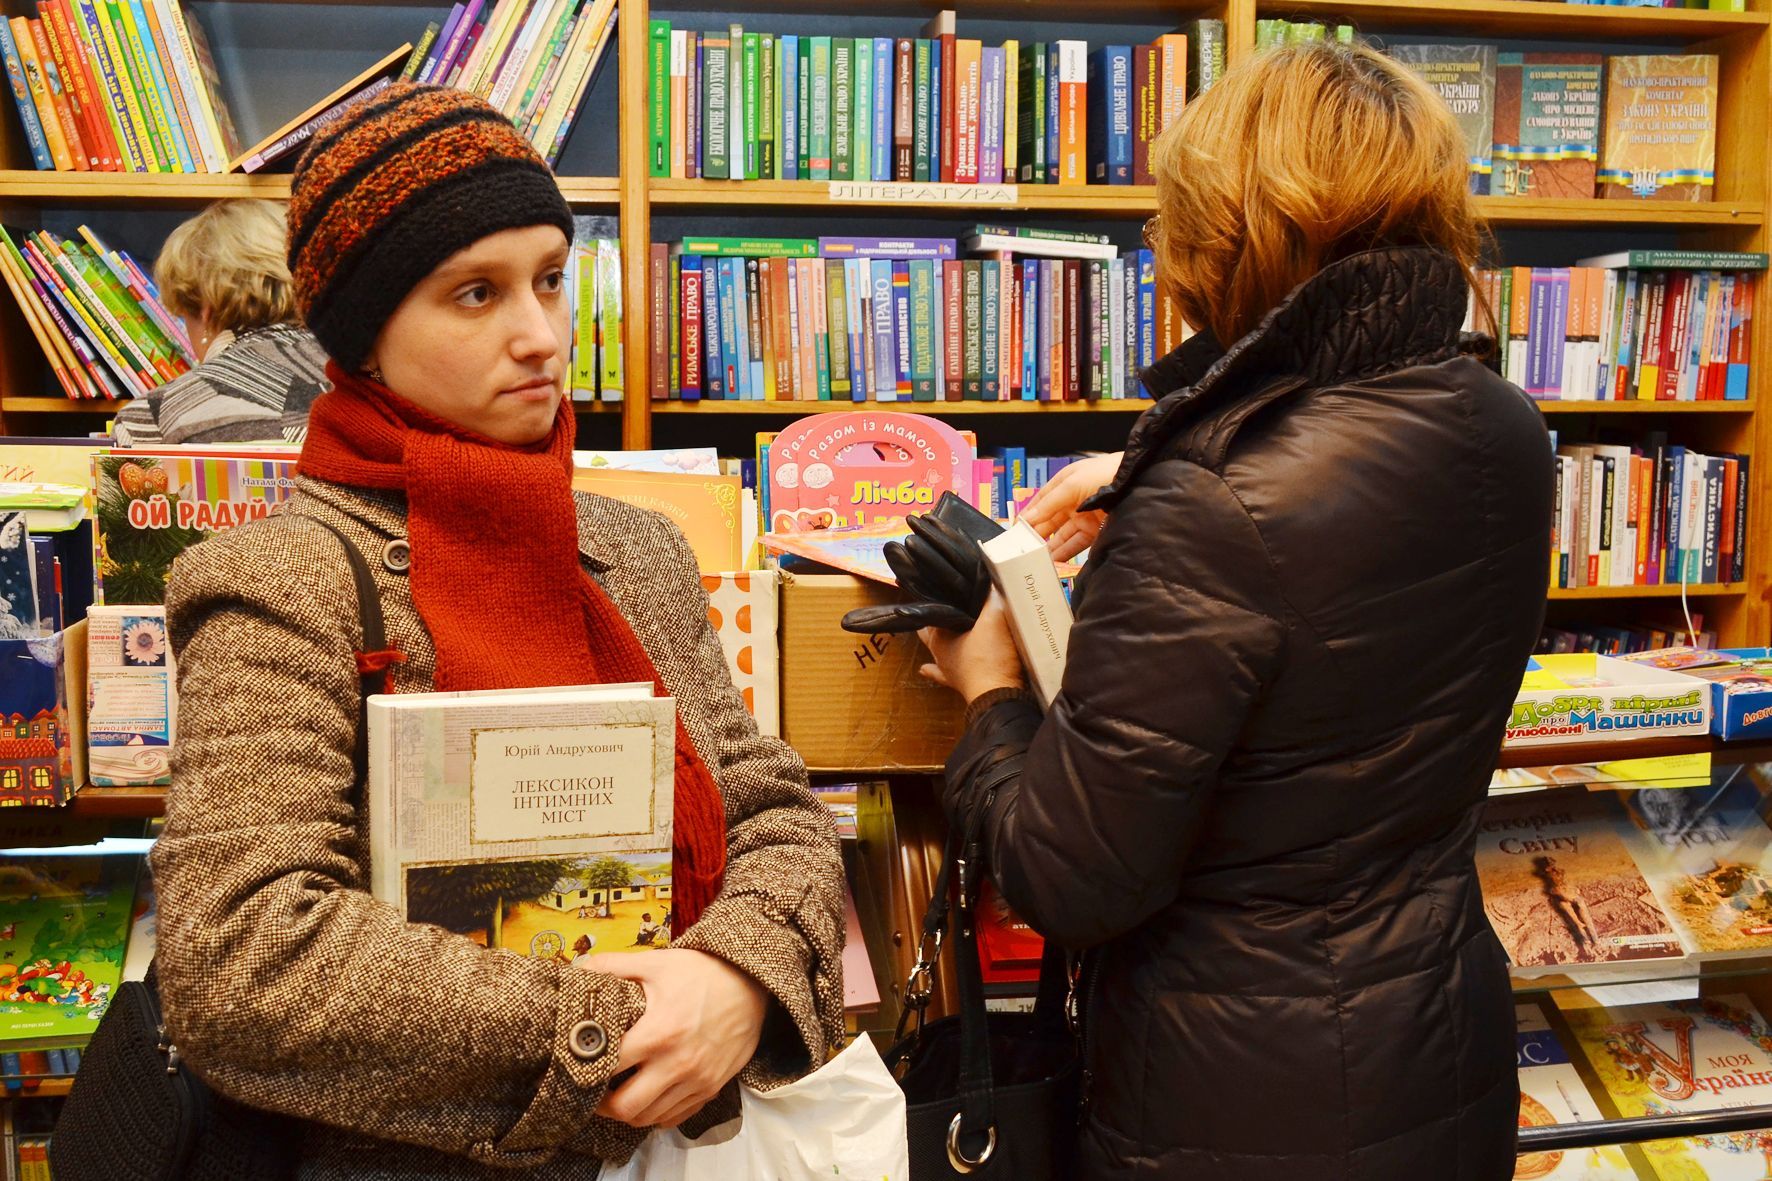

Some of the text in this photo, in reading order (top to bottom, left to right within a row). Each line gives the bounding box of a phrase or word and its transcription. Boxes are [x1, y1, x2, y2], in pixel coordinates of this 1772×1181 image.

[400, 29, 438, 76] ДИНОЗАВРИ
[655, 42, 663, 75] УКРАЇНИ
[762, 49, 770, 78] України
[1202, 31, 1212, 80] СІМЕЙНЕ
[105, 75, 118, 94] ніч
[655, 76, 663, 101] ПРАВО
[764, 79, 772, 97] право
[899, 54, 909, 133] Трудове право України
[918, 46, 927, 156] ТРУДОВЕ ПРАВО УКРАЇНИ
[1114, 56, 1129, 134] ЦИВІЛЬНЕ ПРАВО
[1440, 82, 1480, 98] УКРАЇНИ
[1531, 90, 1596, 102] ЗАКОНУ УКРАЇНИ
[1623, 76, 1708, 87] НАУКОВО-ПРАКТИЧНИЙ
[1646, 90, 1684, 100] КОМЕНТАР
[655, 103, 663, 136] АГРАРНЕ
[707, 49, 725, 155] ЕКОЛОГІЧНЕ ПРАВО УКРАЇНИ
[815, 76, 826, 135] ЗЕМЕЛЬНЕ ПРАВО
[836, 48, 848, 156] ЗЕМЕЛЬНЕ ПРАВО УКРАЇНИ
[967, 61, 977, 177] правових документів
[1564, 104, 1595, 114] МІСЦЕВЕ
[1622, 101, 1708, 117] ЗАКОНУ УКРАЇНИ
[956, 81, 967, 177] Зразки цивільно-
[834, 186, 1011, 200] ЛІТЕРАТУРА
[705, 267, 719, 357] МІЖНАРОДНЕ ПРАВО
[876, 278, 891, 334] ПРАВО
[915, 269, 932, 373] ПОДАТКОВЕ ПРАВО України
[949, 270, 960, 375] СІМЕЙНЕ ПРАВО України
[966, 270, 979, 373] УКРАЇНСЬКЕ СІМЕЙНЕ ПРАВО
[985, 270, 998, 374] СІМЕЙНЕ ПРАВО України
[1127, 298, 1135, 345] ПРОКУРАТУРА
[1164, 296, 1172, 324] Україні
[686, 277, 697, 385] РИМСЬКЕ ПРАВО
[898, 297, 909, 372] ПРАВОЗНАВСТВО
[1114, 313, 1122, 367] ПРОКУРАТУРА
[1142, 292, 1152, 366] ПРОКУРАТУРА УКРАЇНИ
[808, 419, 936, 461] Разом із мамою
[241, 476, 276, 487] Наталя
[852, 486, 935, 513] Лічба
[130, 496, 279, 531] ОЙ РАДУЙ
[1581, 494, 1589, 538] МЕНЕДЖМЕНТ
[1670, 495, 1679, 543] СТАТИСТИКА
[1705, 477, 1717, 566] СТАТИСТИКА
[1736, 471, 1745, 566] ДОСЛІДЖЕННЯ ОПЕРАЦІЙ
[1021, 572, 1065, 661] Юрій Андрухович
[1508, 691, 1702, 729] Добрі вірші
[1540, 709, 1704, 732] про Машинки
[504, 743, 624, 758] Юрій Андрухович
[1506, 724, 1584, 739] улюблені
[511, 776, 615, 793] ЛЕКСИКОН
[513, 792, 614, 809] ІНТИМНИХ
[541, 809, 586, 825] МІСТ
[1480, 813, 1572, 834] сторія
[1499, 834, 1578, 855] Світу
[1707, 1054, 1753, 1069] МОЯ
